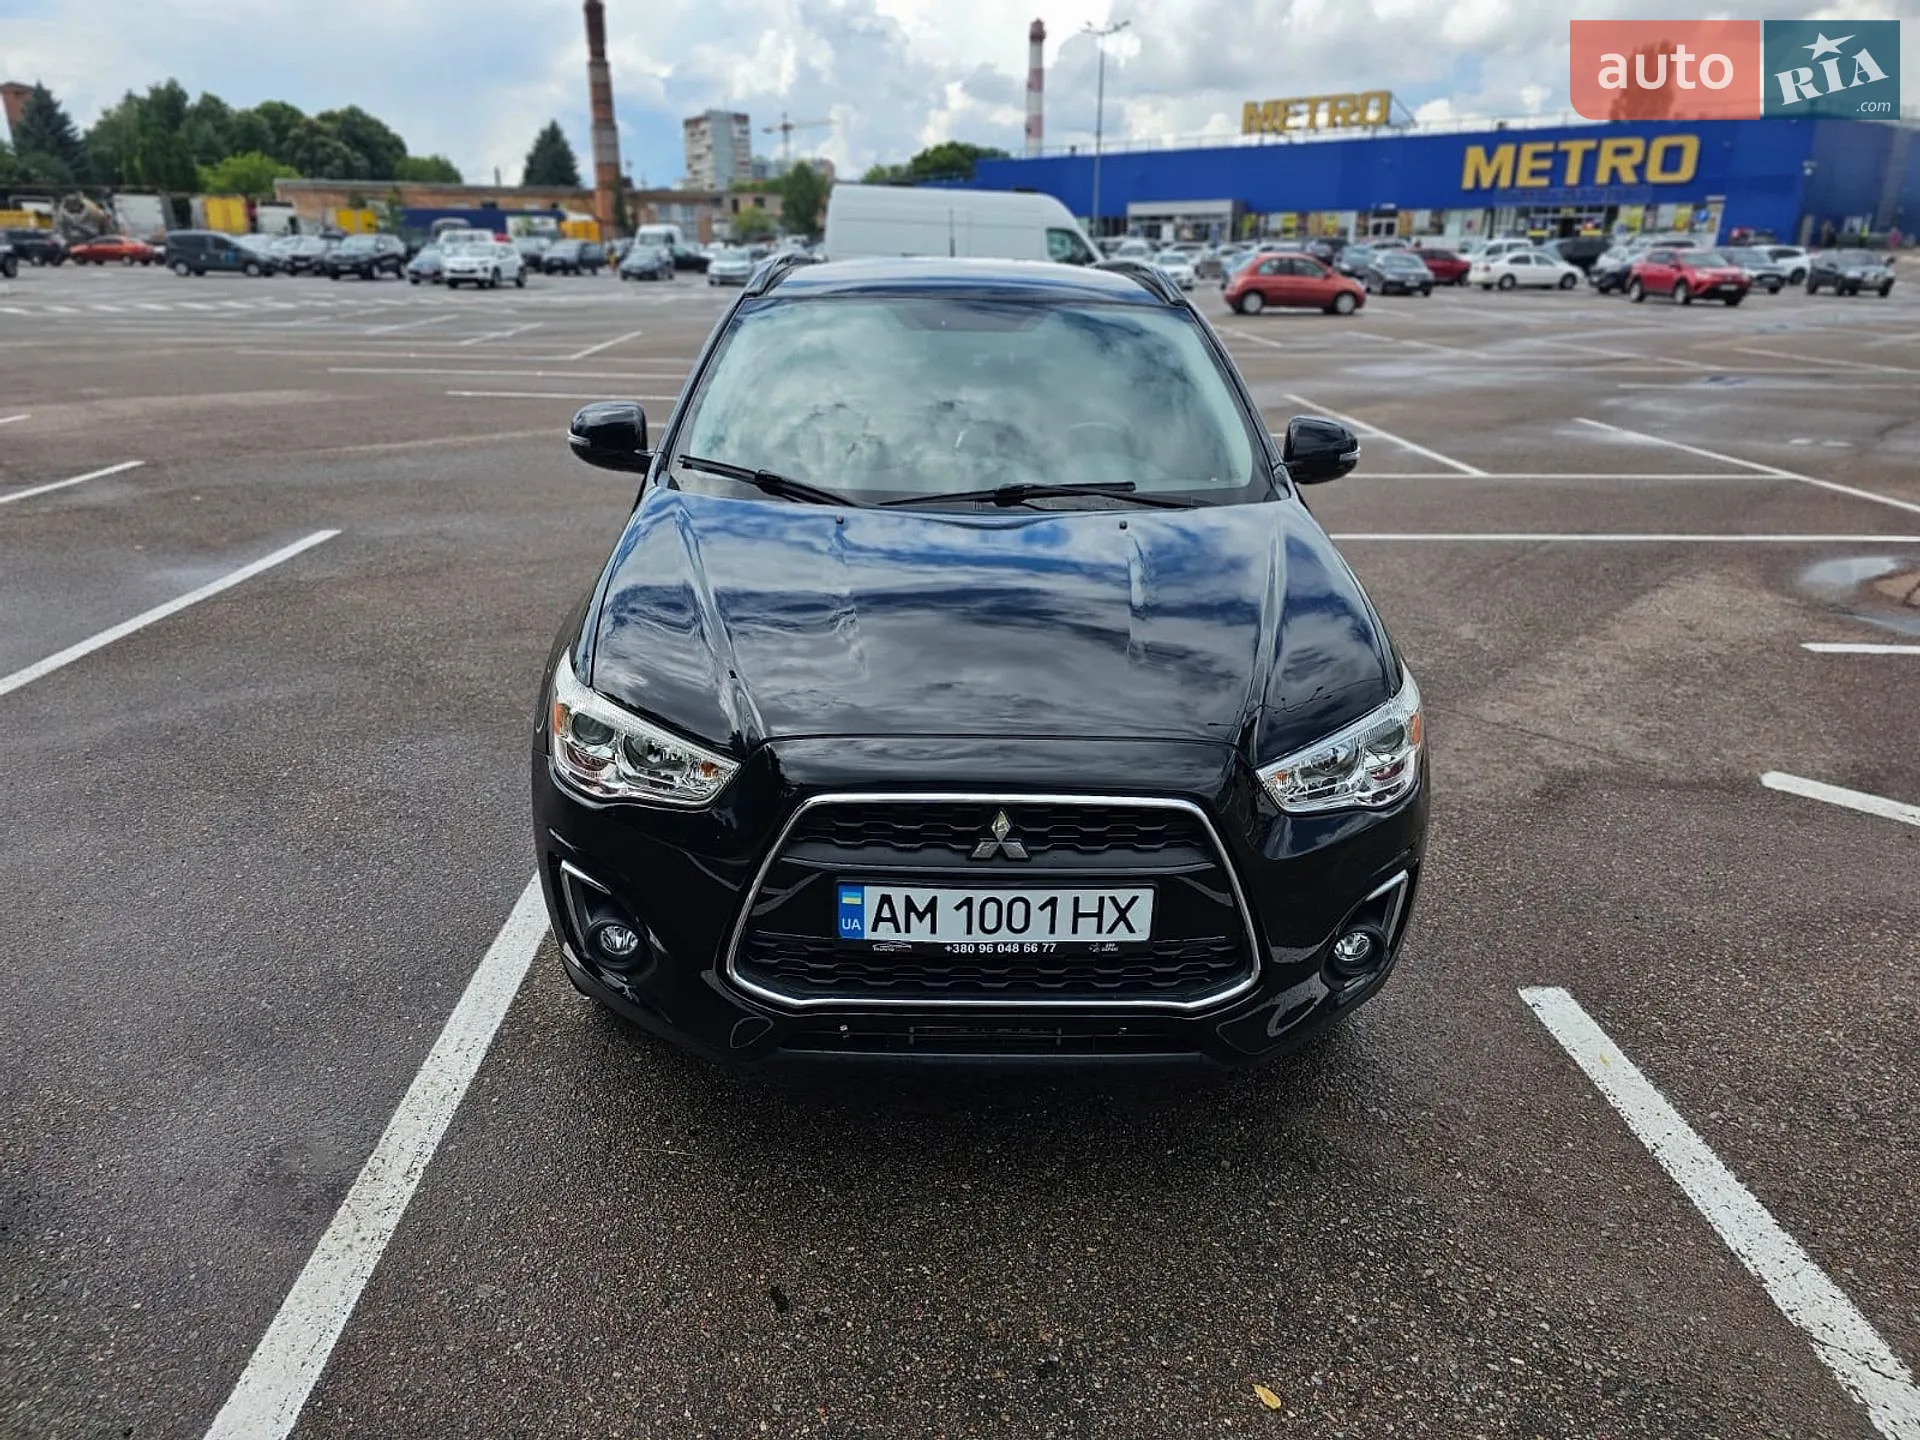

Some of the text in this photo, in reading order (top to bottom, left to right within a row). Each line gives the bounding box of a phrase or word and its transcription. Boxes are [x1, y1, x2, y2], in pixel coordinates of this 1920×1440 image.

[1242, 90, 1393, 135] METRO
[1461, 134, 1700, 190] METRO
[842, 918, 861, 931] UA
[871, 893, 1140, 936] AM 1001 HX
[944, 943, 1057, 953] +380 96 048 66 77
